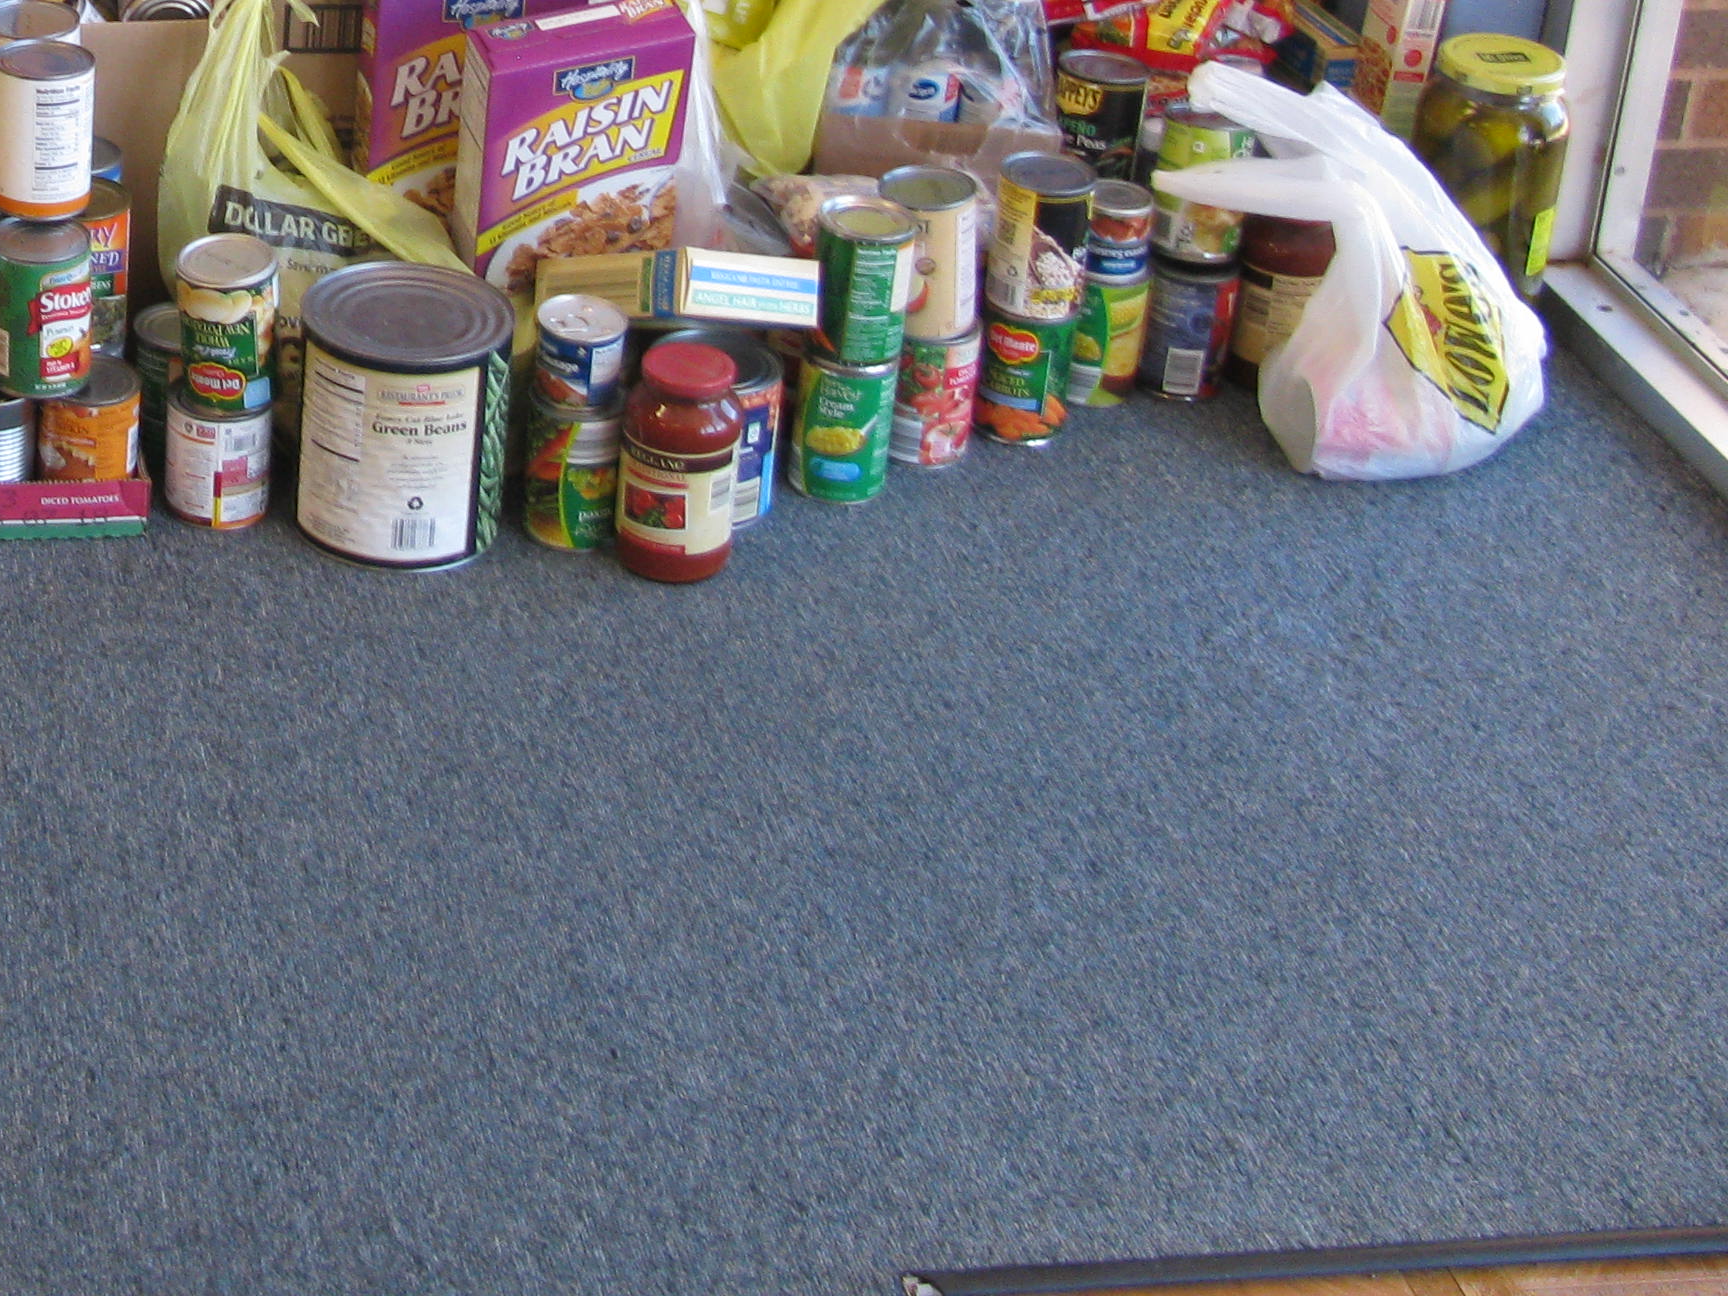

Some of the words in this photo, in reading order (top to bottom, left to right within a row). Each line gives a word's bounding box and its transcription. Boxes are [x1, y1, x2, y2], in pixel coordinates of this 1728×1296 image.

[501, 79, 672, 176] RAISIN
[512, 118, 654, 201] BRAN
[224, 201, 316, 241] DOLLAR
[372, 421, 418, 437] Green
[424, 420, 467, 436] Beans
[41, 497, 69, 505] DICED
[71, 494, 120, 505] TOMATOES
